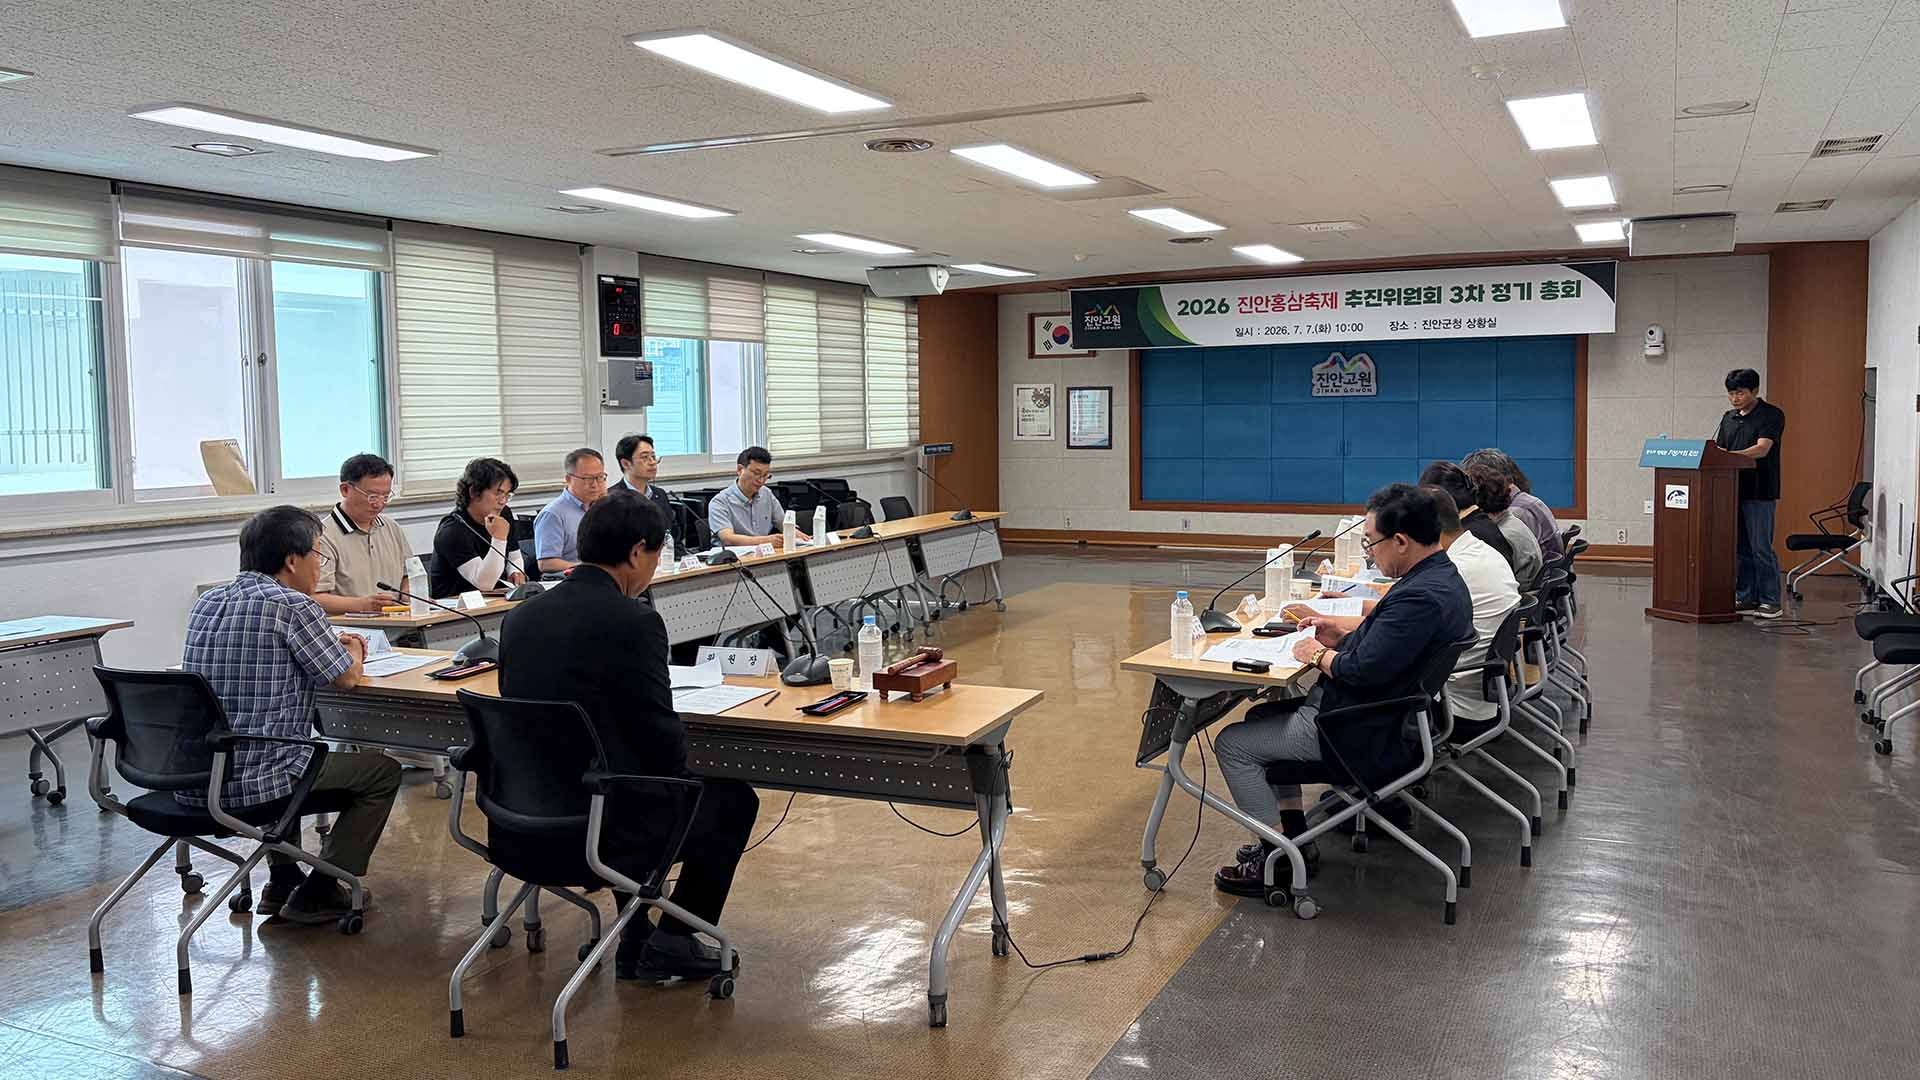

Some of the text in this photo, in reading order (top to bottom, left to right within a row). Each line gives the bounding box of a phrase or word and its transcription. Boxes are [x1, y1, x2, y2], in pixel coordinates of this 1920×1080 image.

[1177, 279, 1582, 316] 2026 진안홍삼축제 추진위원회 3차 정기 총회
[1084, 315, 1121, 327] 진안고원
[1235, 326, 1253, 337] 일시
[1264, 324, 1290, 336] 2026.
[1294, 325, 1303, 334] 7.
[1307, 323, 1333, 335] 7.(화)
[1335, 322, 1364, 334] 10:00
[1389, 320, 1409, 331] 장소
[1422, 317, 1462, 330] 진안군청
[1466, 317, 1497, 329] 상황실
[1316, 372, 1372, 387] 진안고원
